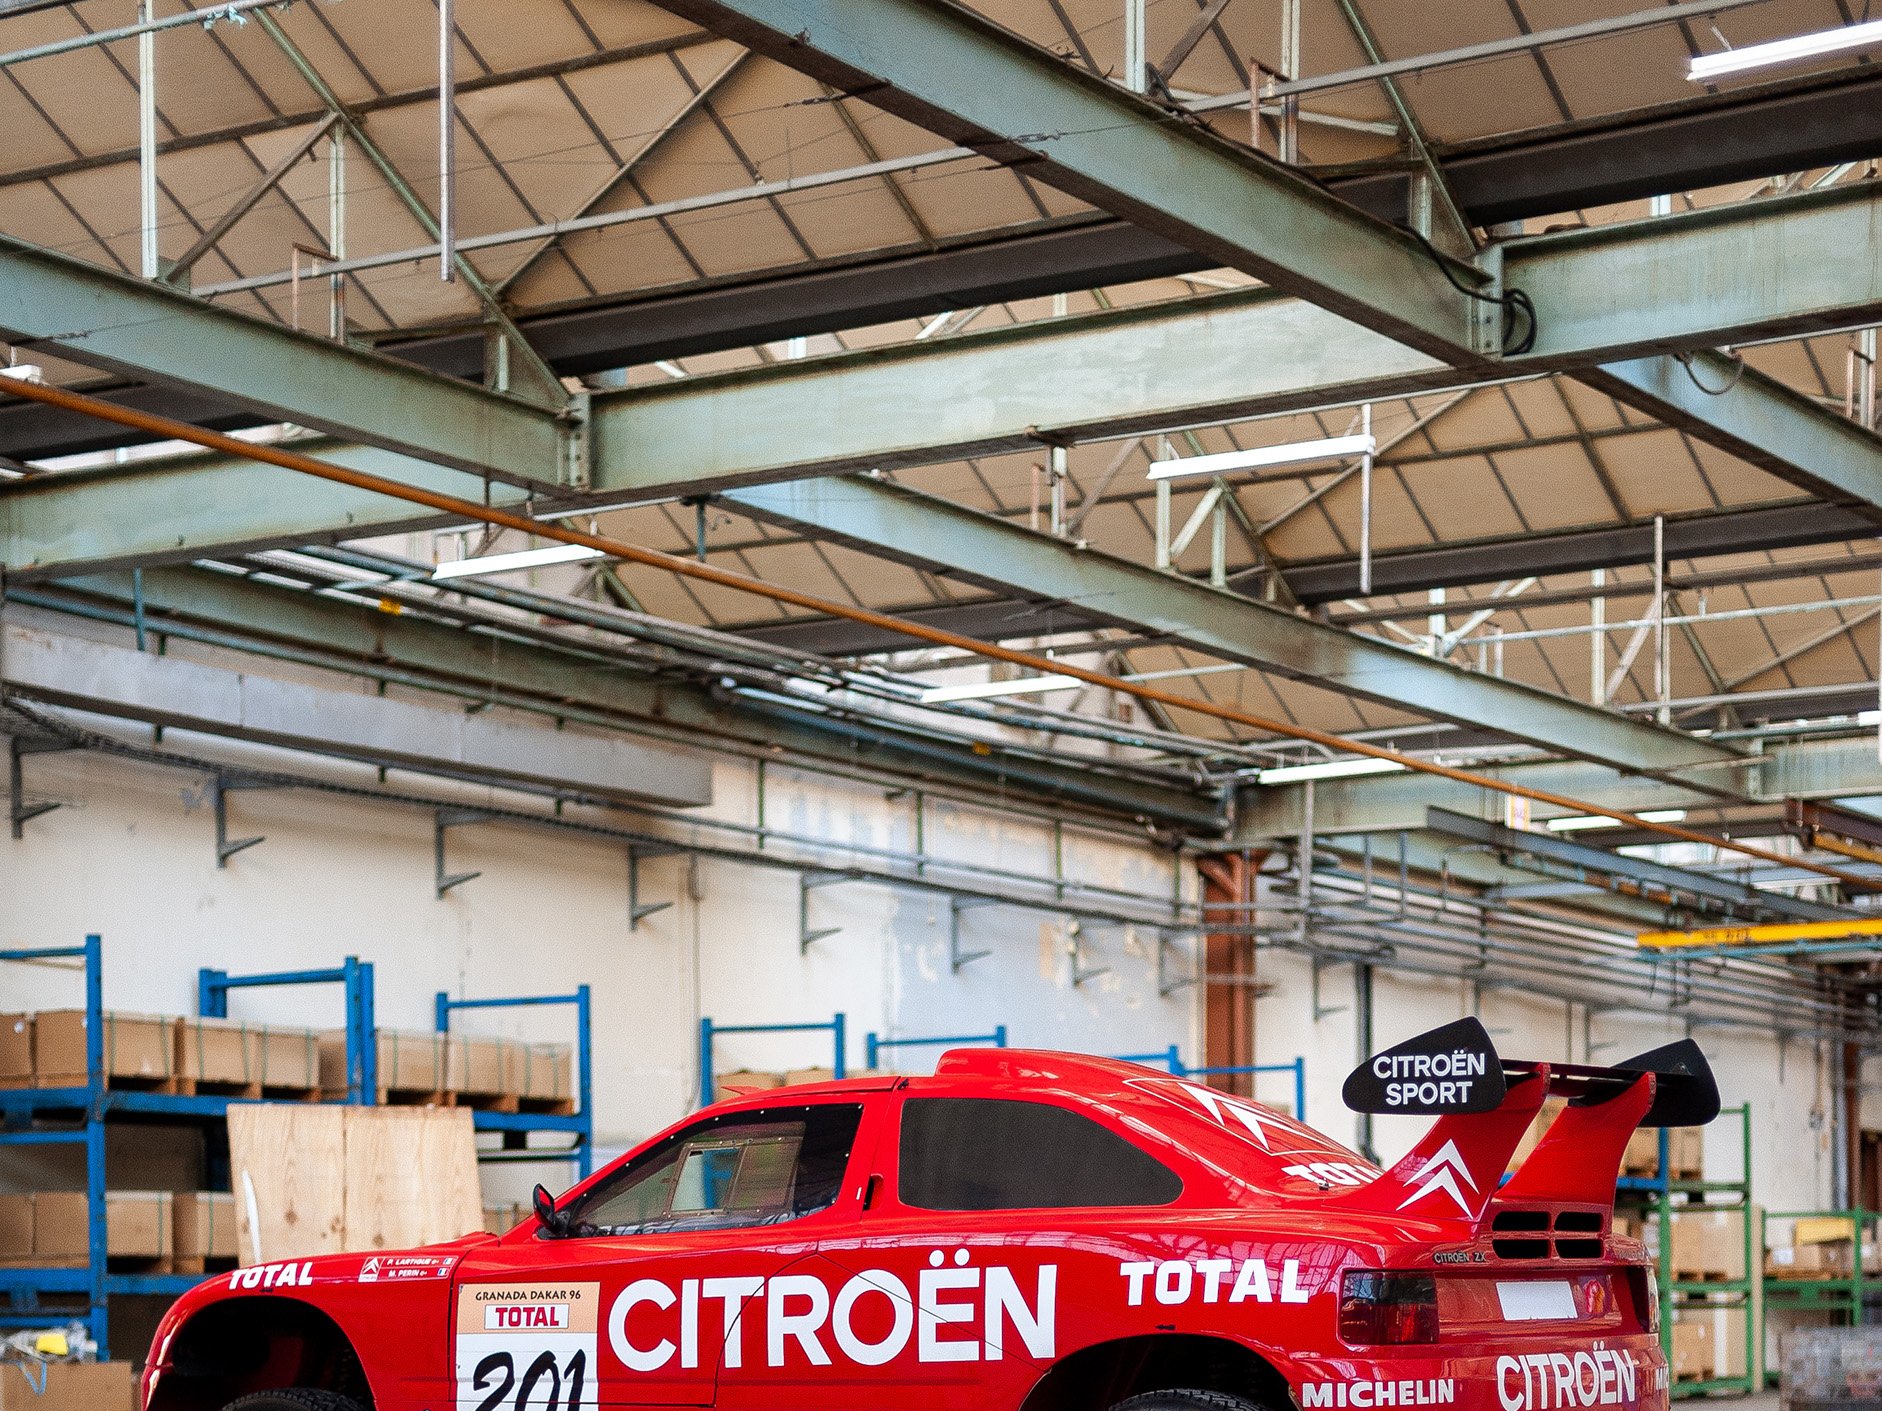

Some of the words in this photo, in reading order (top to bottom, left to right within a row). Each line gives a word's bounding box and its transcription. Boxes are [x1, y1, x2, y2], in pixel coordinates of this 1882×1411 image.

[1373, 1049, 1486, 1079] CITROËN
[1385, 1081, 1473, 1106] SPORT
[1473, 1251, 1487, 1262] ZX
[228, 1261, 313, 1290] TOTAL
[398, 1269, 420, 1277] PERIN
[1119, 1258, 1309, 1307] TOTAL
[475, 1291, 527, 1301] GRANADA
[530, 1290, 567, 1300] DAKAR
[569, 1290, 581, 1300] 96
[495, 1306, 560, 1327] TOTAL
[608, 1248, 1058, 1372] CITROËN
[1302, 1378, 1454, 1408] MICHELIN
